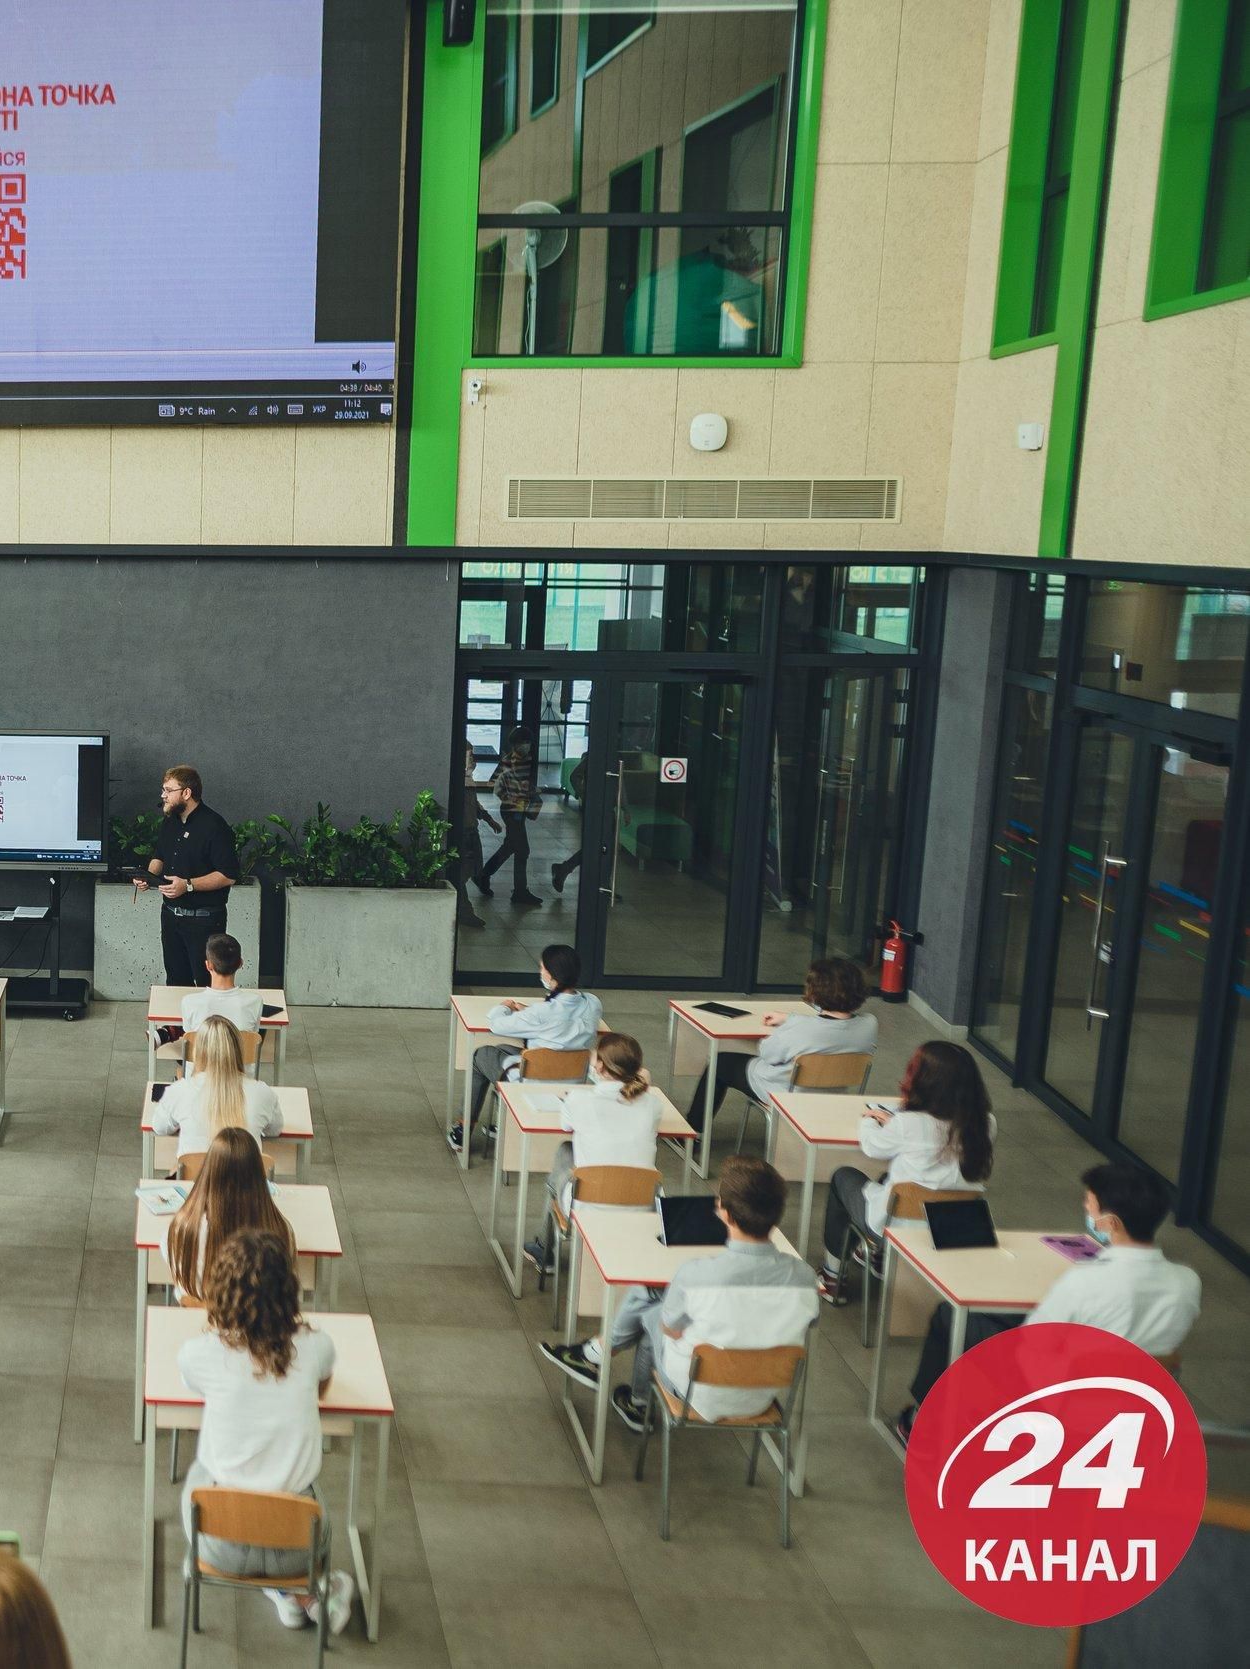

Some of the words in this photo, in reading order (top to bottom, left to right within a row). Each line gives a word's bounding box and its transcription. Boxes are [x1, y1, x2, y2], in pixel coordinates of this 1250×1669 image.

[38, 84, 117, 107] ТОЧКА
[344, 399, 361, 408] 11:12
[179, 407, 194, 416] 9°C
[198, 406, 216, 415] Rain
[334, 411, 369, 420] 29.09.2021
